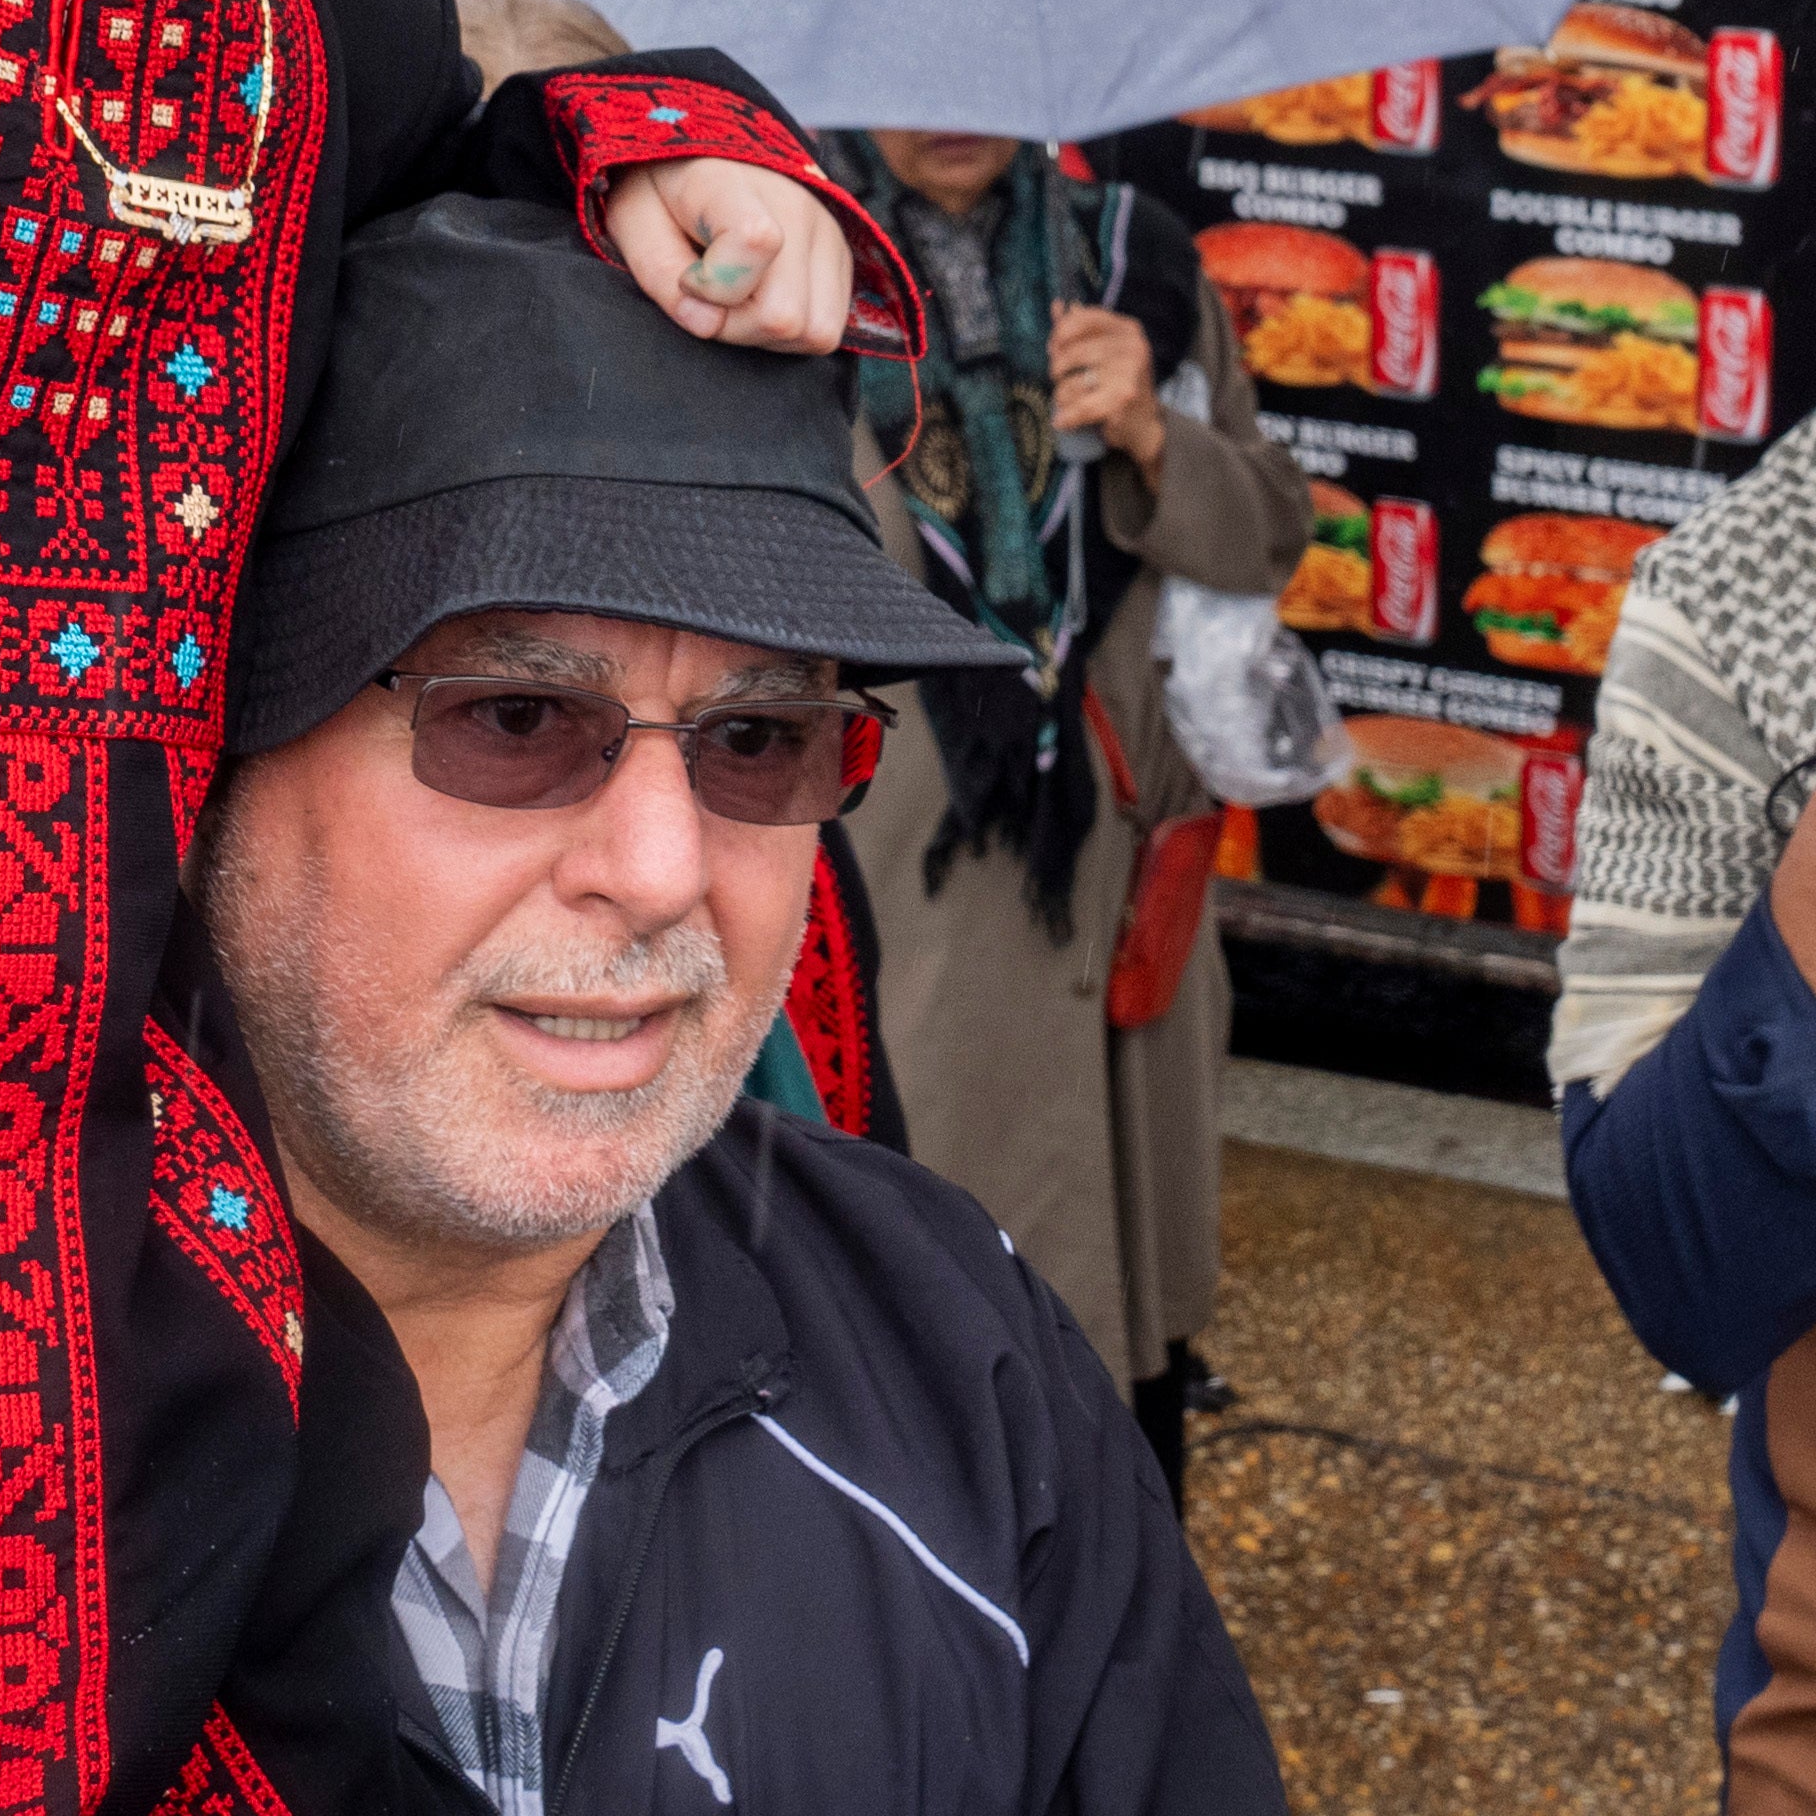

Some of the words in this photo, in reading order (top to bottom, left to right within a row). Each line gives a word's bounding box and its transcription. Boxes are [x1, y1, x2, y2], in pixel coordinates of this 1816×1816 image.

[127, 174, 236, 222] FERIEL
[1199, 158, 1260, 192] BBQ
[1264, 163, 1382, 206] BURGER
[1233, 193, 1346, 228] COMBO
[1490, 188, 1612, 229] DOUBLE
[1616, 201, 1741, 245] BURGER
[1555, 227, 1673, 265] COMBO
[1496, 445, 1584, 482] SPICY
[1616, 492, 1696, 525] COM
[1321, 650, 1428, 689] CRISPY
[1430, 668, 1562, 713] CHICKEN
[1446, 700, 1556, 738] COMBO
